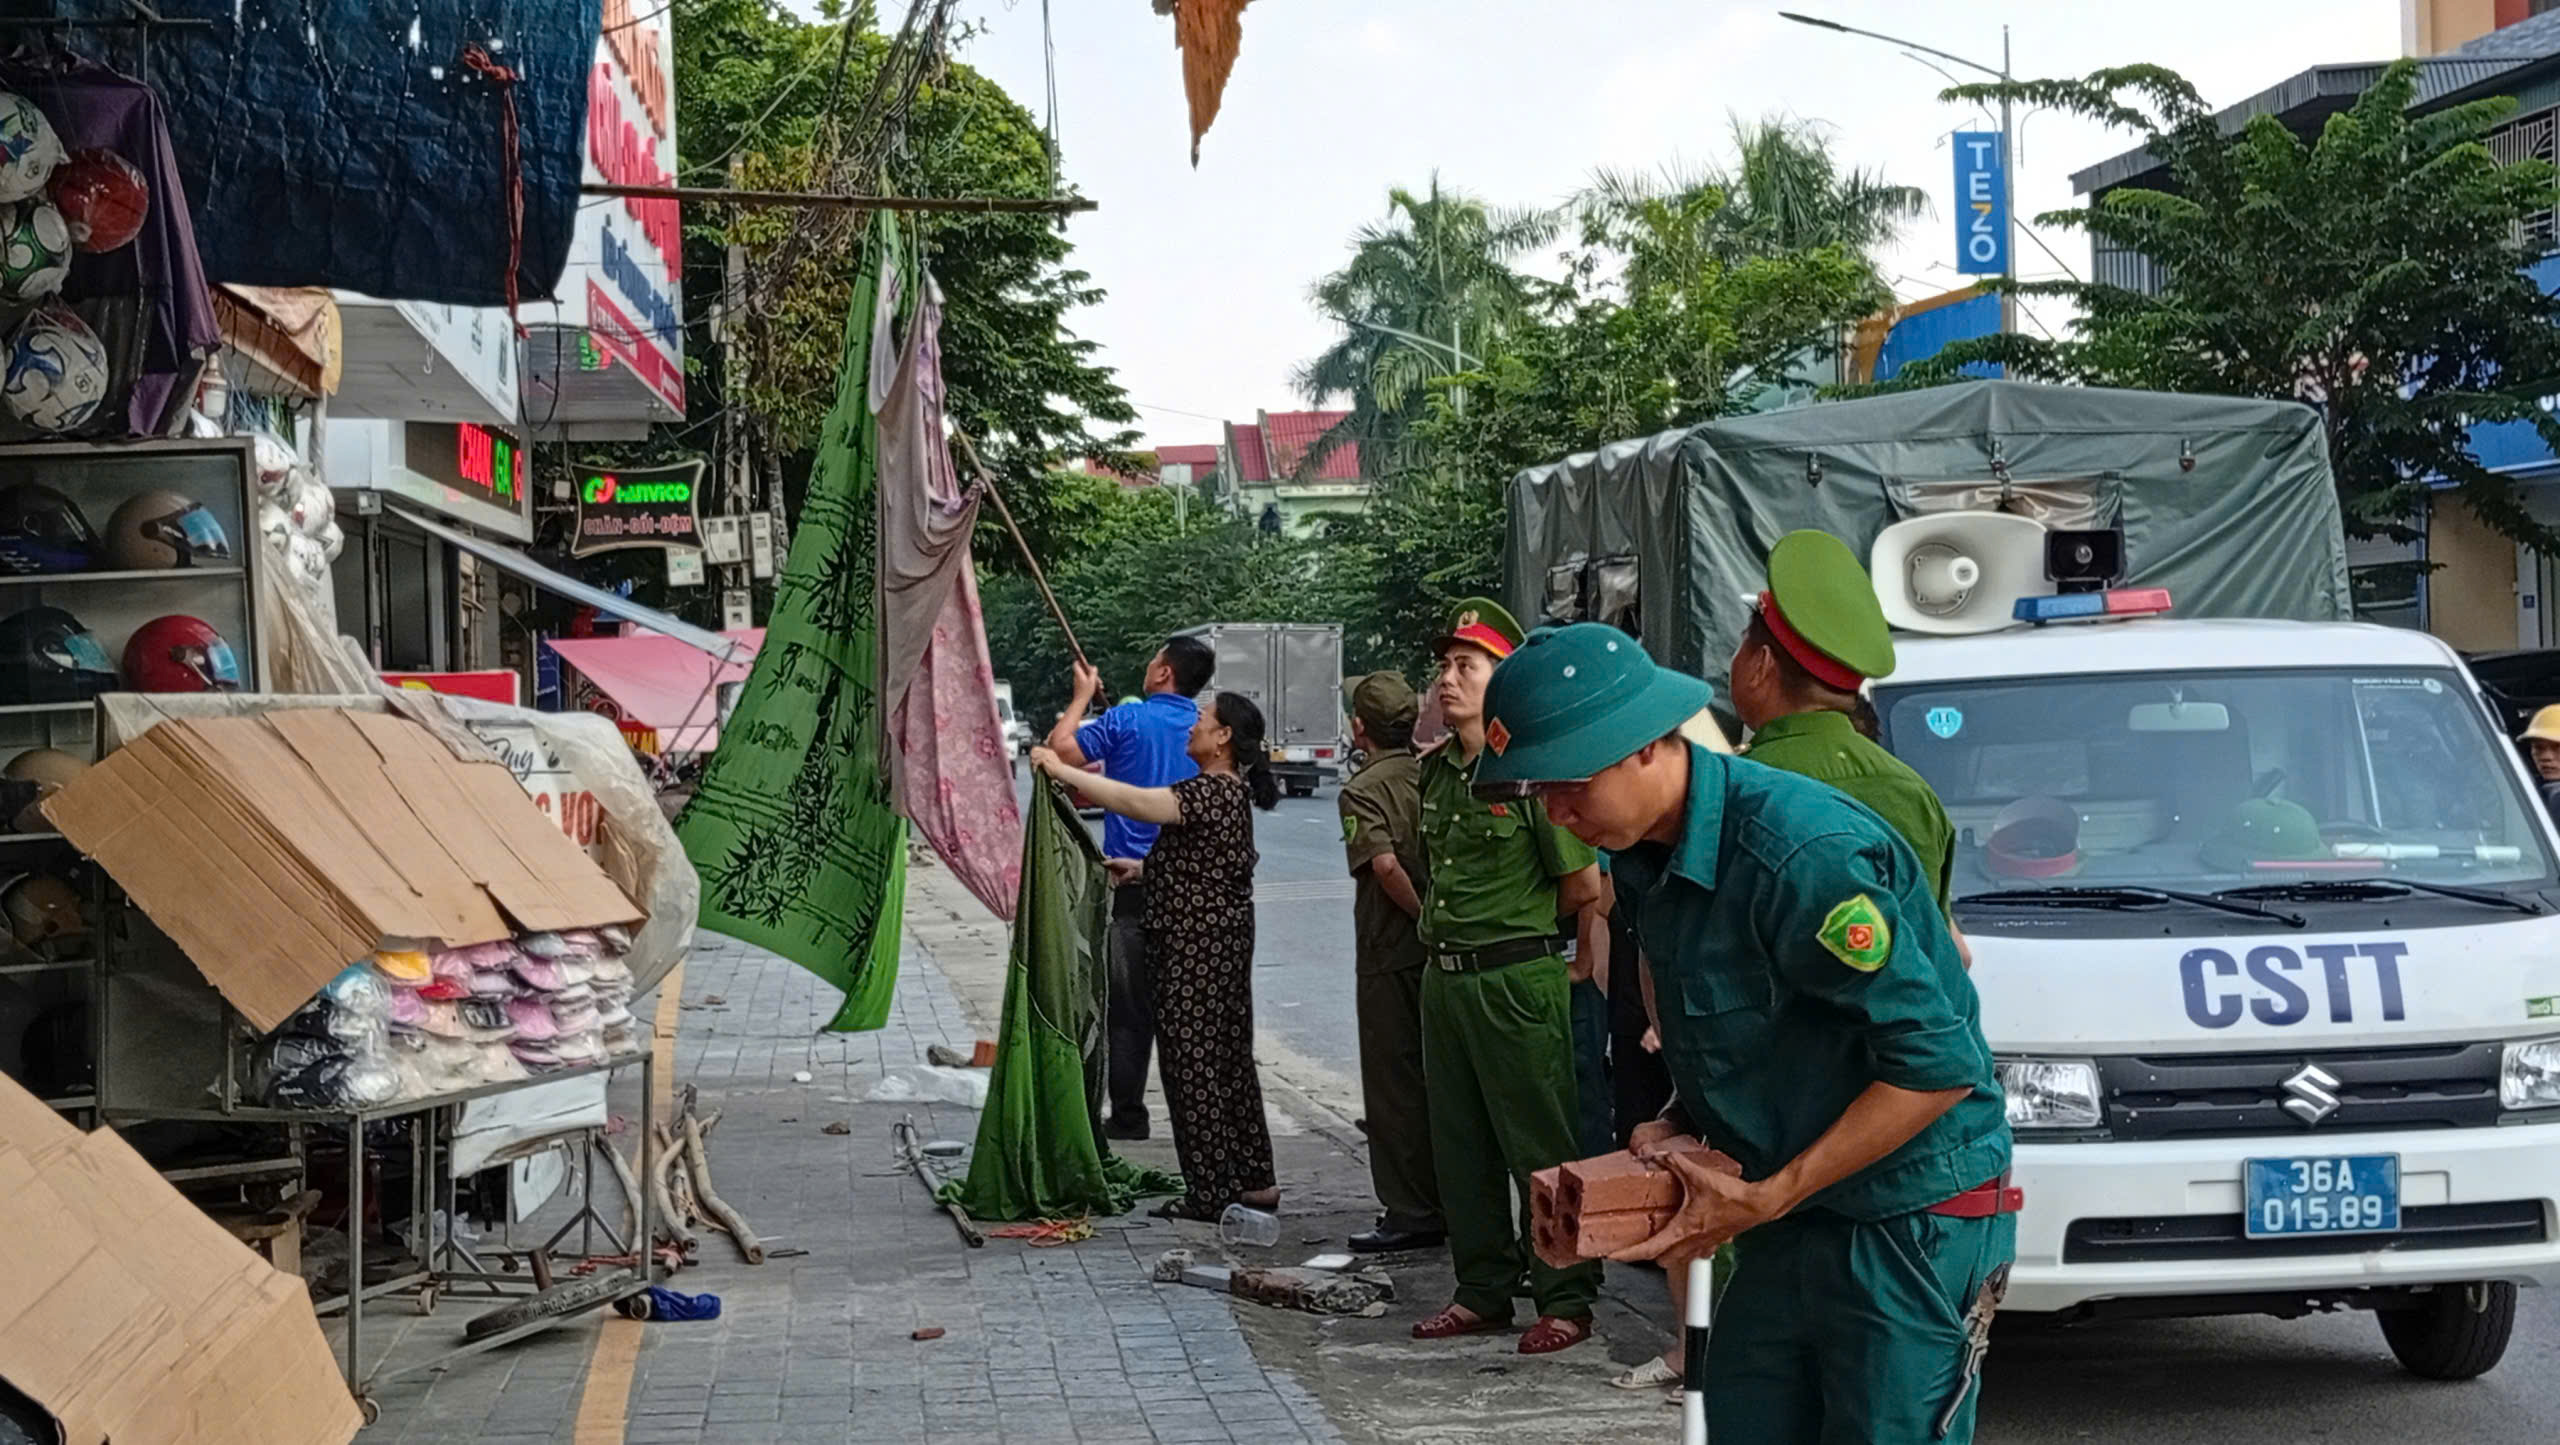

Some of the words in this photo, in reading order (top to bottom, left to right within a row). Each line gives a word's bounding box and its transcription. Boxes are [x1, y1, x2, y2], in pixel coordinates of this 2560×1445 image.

[1966, 141, 1997, 263] TEZO
[2179, 942, 2409, 1029] CSTT
[2290, 1159, 2355, 1194] 36A
[2263, 1195, 2382, 1232] 015.89
